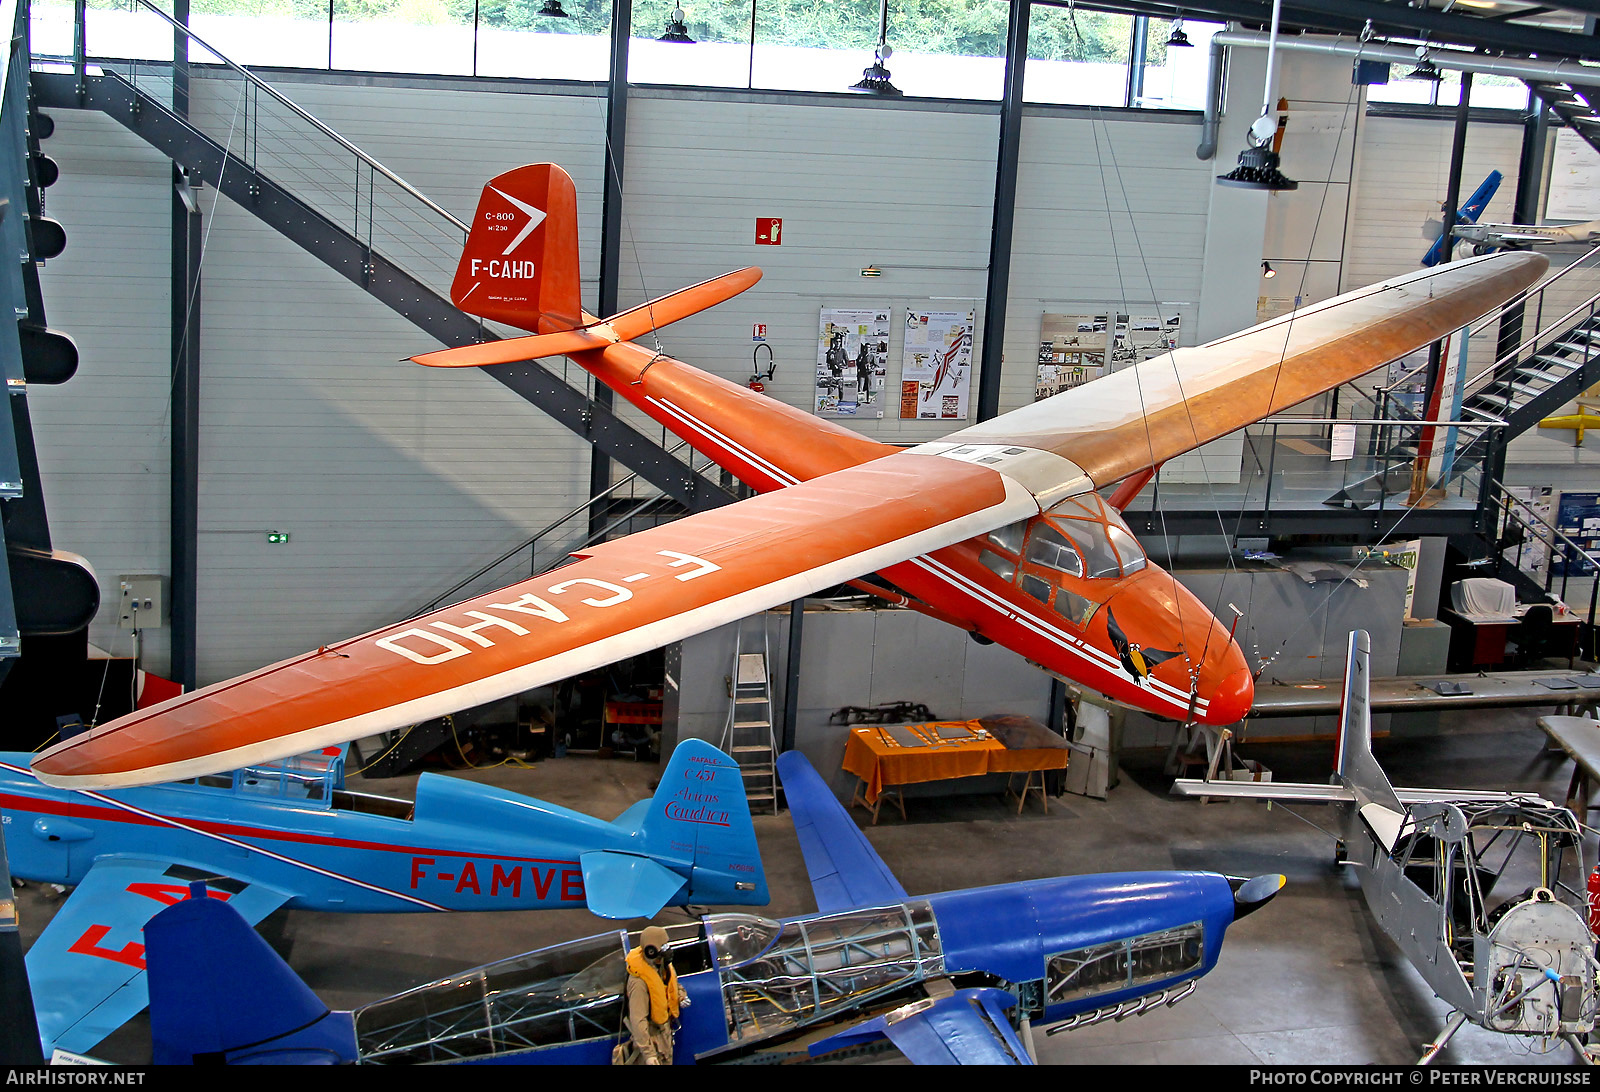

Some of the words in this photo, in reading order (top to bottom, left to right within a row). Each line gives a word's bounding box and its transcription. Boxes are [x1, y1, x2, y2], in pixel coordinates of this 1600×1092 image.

[485, 212, 515, 221] C-800
[471, 258, 535, 279] F-CAHD
[375, 549, 723, 666] F-CAHD
[691, 756, 718, 765] RAFALE
[684, 768, 694, 780] C
[678, 787, 719, 803] Avions
[665, 801, 730, 825] Caudron
[410, 856, 587, 901] F-AMVB
